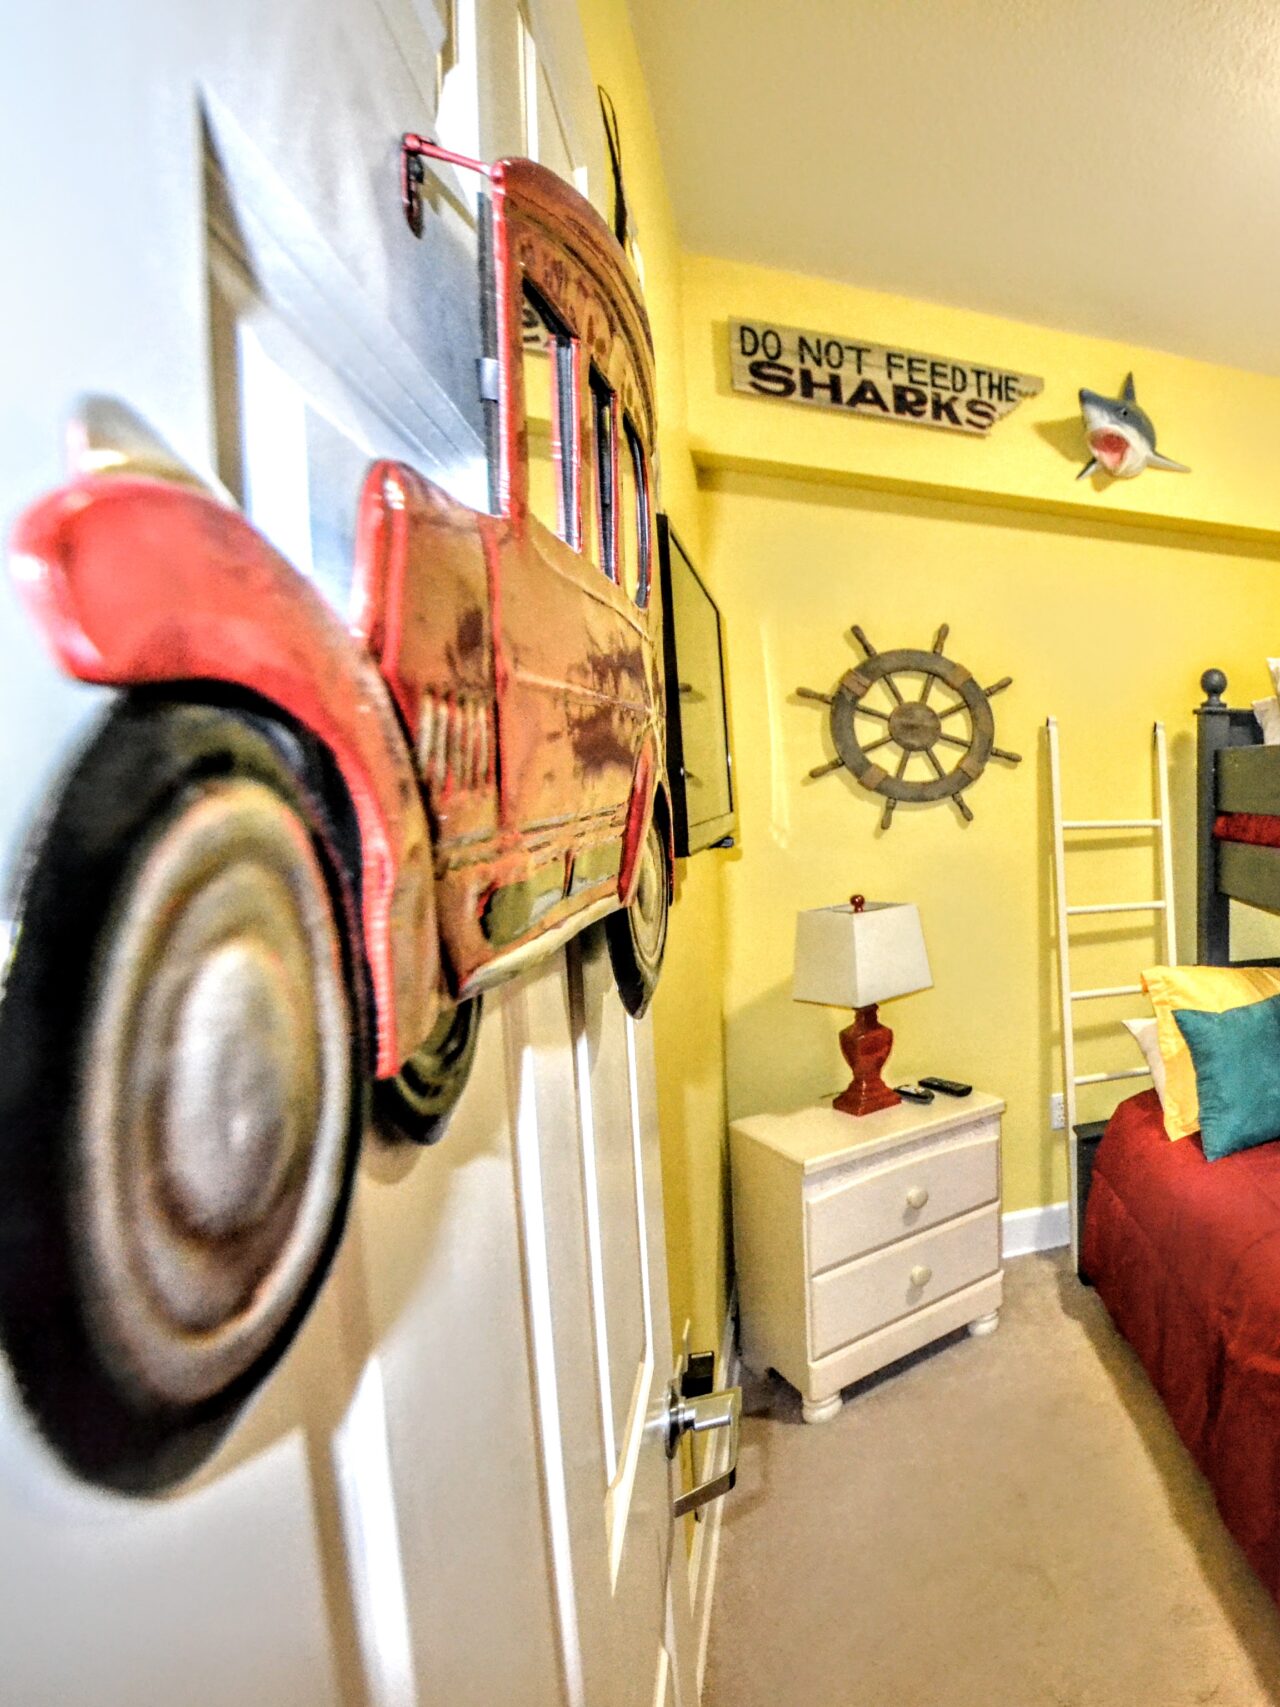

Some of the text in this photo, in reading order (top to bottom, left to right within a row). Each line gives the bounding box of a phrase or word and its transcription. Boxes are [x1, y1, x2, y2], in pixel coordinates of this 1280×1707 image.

[740, 325, 1019, 402] DO NOT FEED THE
[749, 360, 997, 430] SHARKS
